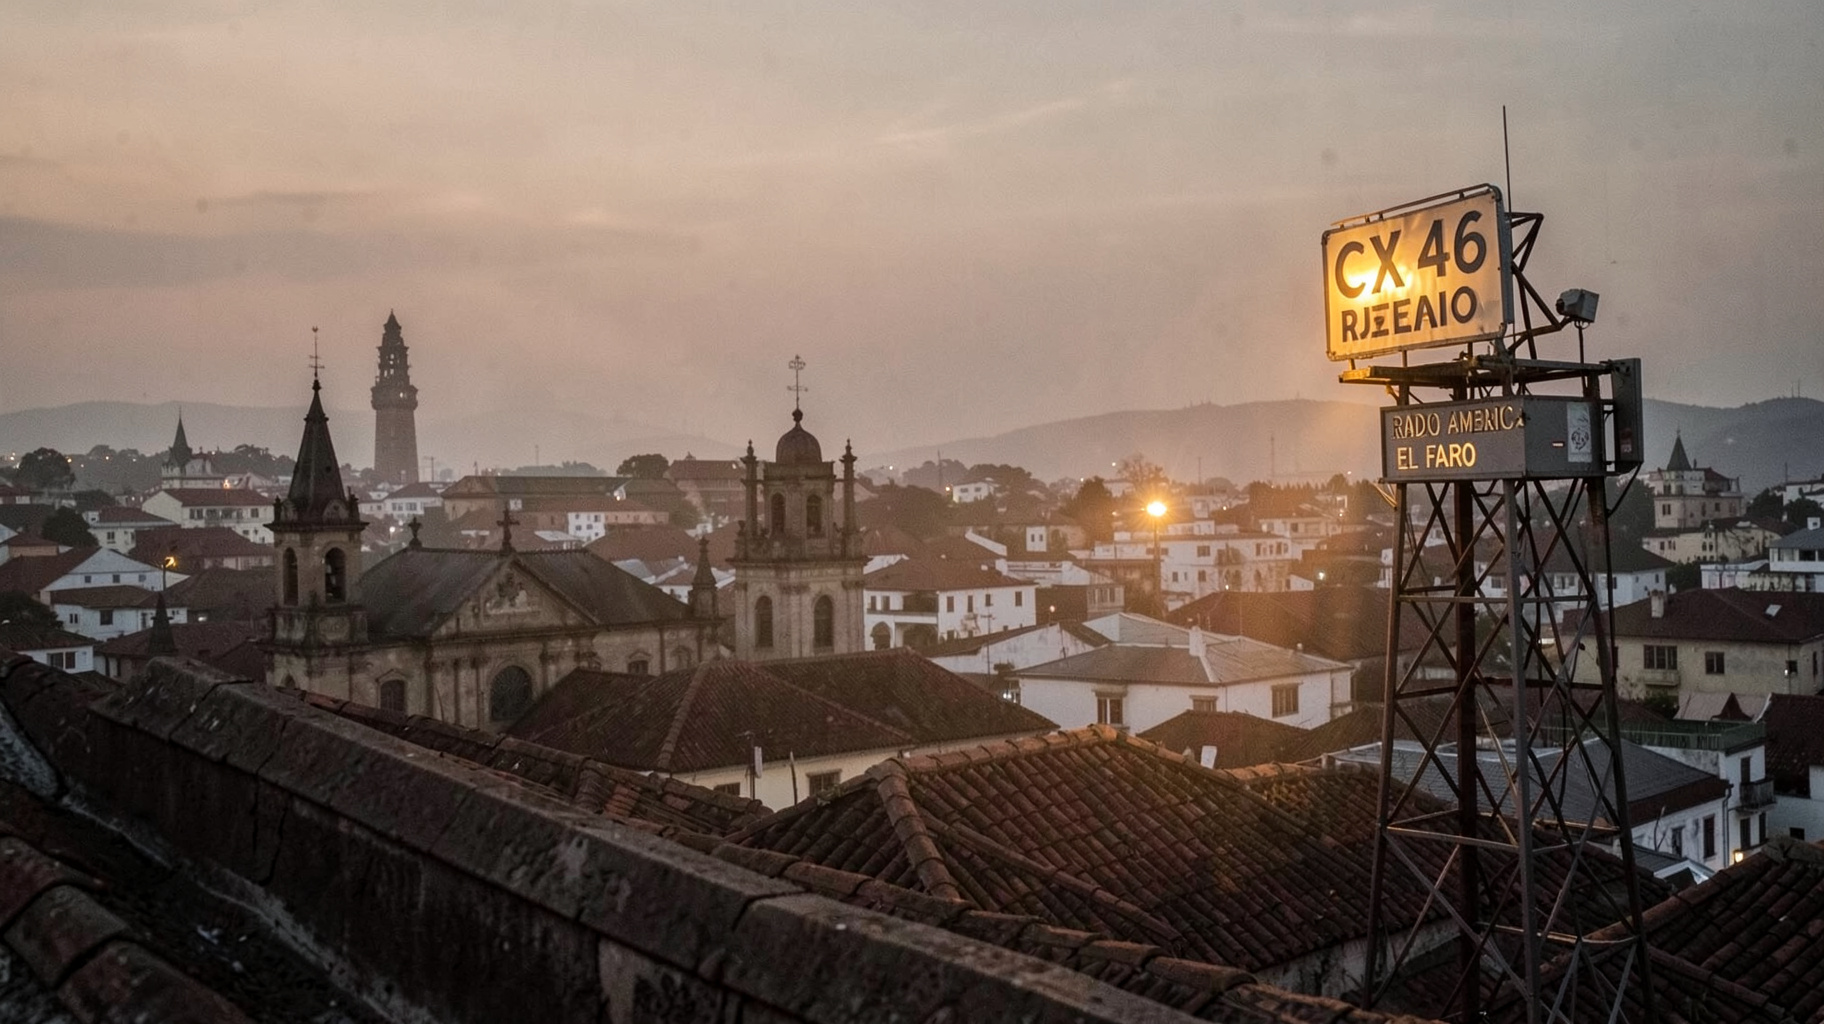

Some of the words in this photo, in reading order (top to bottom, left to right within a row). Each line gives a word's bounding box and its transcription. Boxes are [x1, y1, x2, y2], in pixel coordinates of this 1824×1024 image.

[1335, 230, 1405, 298] CX
[1418, 210, 1487, 277] 46
[1392, 412, 1440, 439] RADO
[1397, 446, 1419, 470] EL
[1426, 442, 1476, 468] FARO
